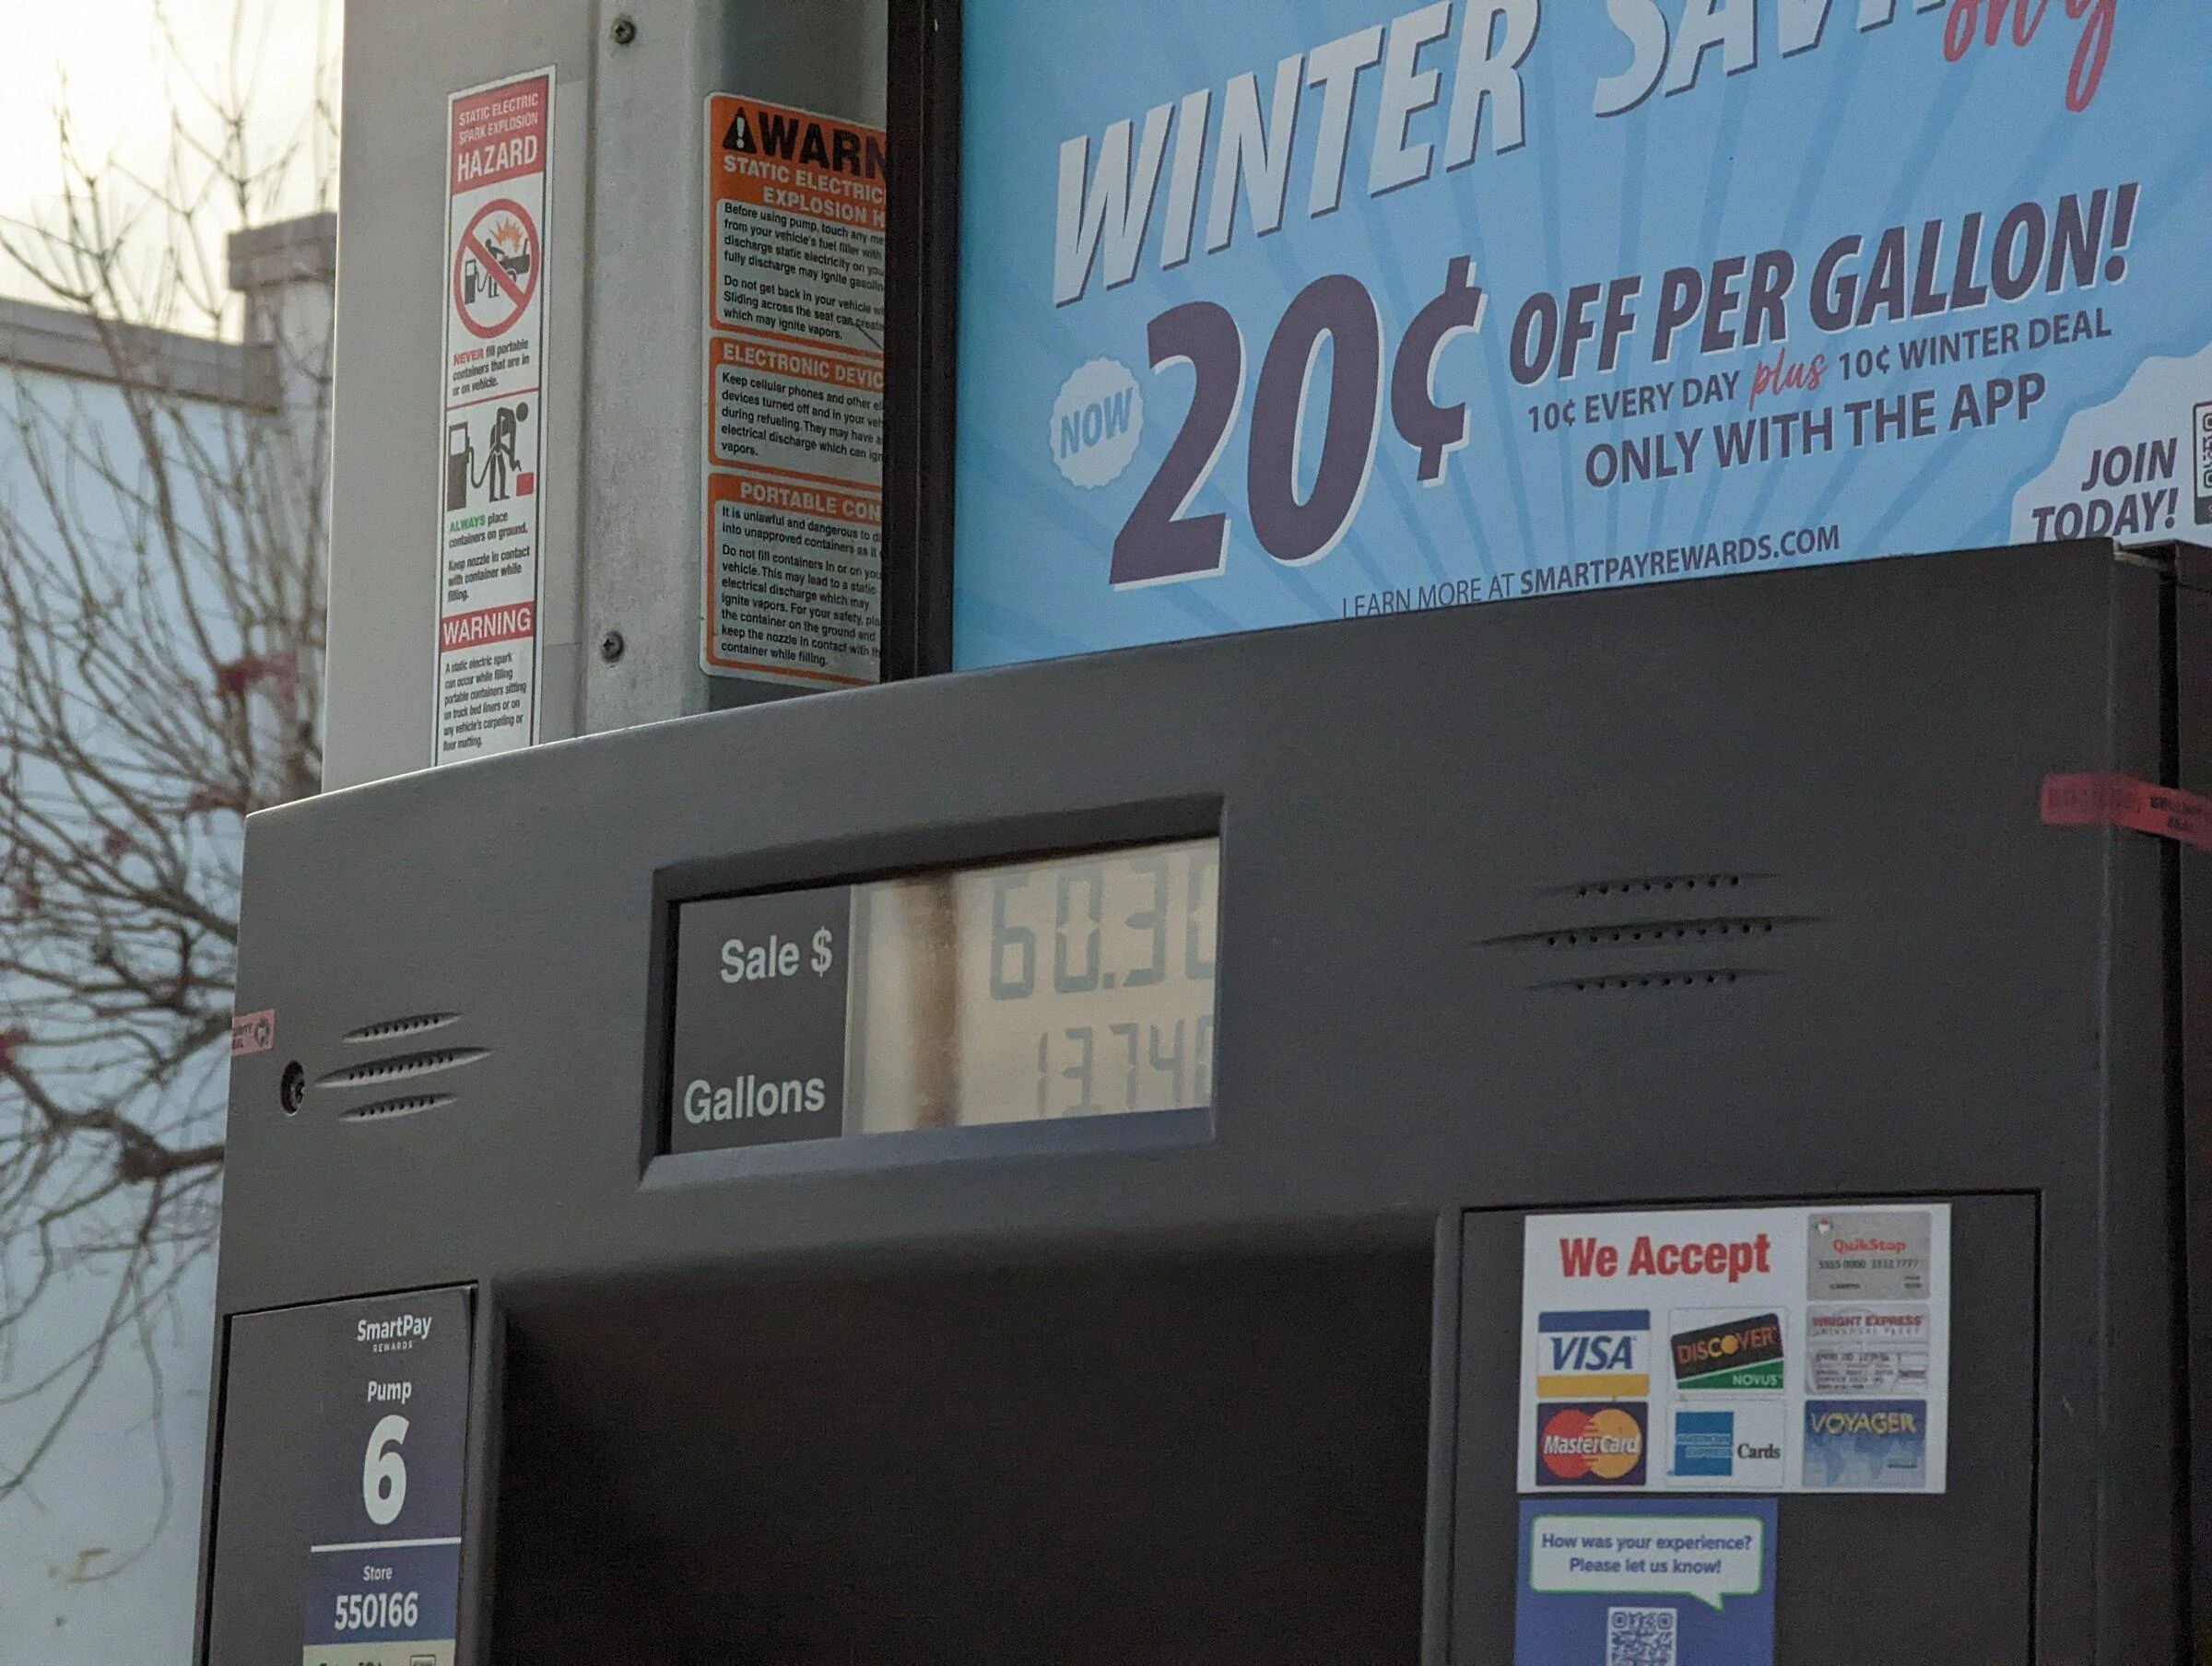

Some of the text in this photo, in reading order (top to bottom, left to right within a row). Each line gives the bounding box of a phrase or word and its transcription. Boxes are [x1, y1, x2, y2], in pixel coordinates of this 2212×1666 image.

[459, 93, 539, 126] STATIC ELECTRIC
[459, 111, 539, 146] SPARK EXPLOSION
[457, 135, 538, 182] HAZARD
[724, 154, 790, 183] STATIC
[1053, 0, 1541, 309] WINTER
[724, 202, 758, 218] Before
[760, 209, 787, 227] using
[821, 221, 848, 239] touch
[851, 230, 868, 244] any
[762, 185, 867, 225] EXPLOSION
[724, 217, 882, 261] from your vehicle's fuel filler with
[724, 235, 865, 274] discharge static electricity on
[724, 251, 746, 265] fully
[748, 255, 796, 276] discharge
[799, 267, 818, 278] may
[820, 270, 847, 286] ignite
[1509, 182, 2139, 387] OFF PER GALLON!
[453, 338, 528, 366] NEVER fill portable
[724, 343, 830, 378] ELECTRONIC
[1528, 307, 2112, 433] 10¢ EVERY DAY plus 10¢ WINTER DEAL
[722, 389, 865, 425] devices turned off and in your
[723, 371, 870, 409] Keep cellular phones and other
[722, 406, 874, 443] during refueling. They may have
[1059, 386, 1134, 460] NOW
[1109, 254, 1488, 591] 20¢
[1585, 372, 2046, 489] ONLY WITH THE APP
[721, 425, 866, 459] electrical discharge which can
[721, 441, 759, 456] vapors.
[2081, 437, 2178, 492] JOIN
[740, 482, 836, 514] PORTABLE
[2032, 487, 2179, 543] TODAY!
[723, 506, 869, 541] It is unlawful and dangerous to
[1418, 578, 1482, 609] MORE
[1488, 572, 1515, 599] AT
[1520, 525, 1841, 595] SMARTPAYREWARDS.COM
[722, 577, 869, 611] electrical discharge which may
[722, 592, 864, 626] ignite vapors. For your safety,
[443, 607, 532, 645] WARNING
[721, 642, 828, 667] container while filling.
[720, 925, 833, 984] Sale $
[684, 1075, 826, 1125] Gallons
[1559, 1233, 1771, 1284] We Accept
[1832, 1238, 1907, 1254] QuikStop
[357, 1314, 432, 1342] SmartPay
[1676, 1325, 1775, 1365] DISCOVER
[372, 1340, 413, 1353] REWARDS
[1551, 1335, 1634, 1371] VISA
[367, 1380, 412, 1404] Pump
[1732, 1373, 1778, 1387] NOVUS
[1810, 1412, 1918, 1435] VOYAGER
[1543, 1435, 1640, 1456] MasterCard
[1737, 1442, 1782, 1461] Cards
[362, 1414, 410, 1526] 6
[1541, 1533, 1752, 1553] How was your experience?
[363, 1565, 392, 1582] Store
[1569, 1557, 1722, 1574] Please let us know!
[334, 1591, 418, 1632] 550166
